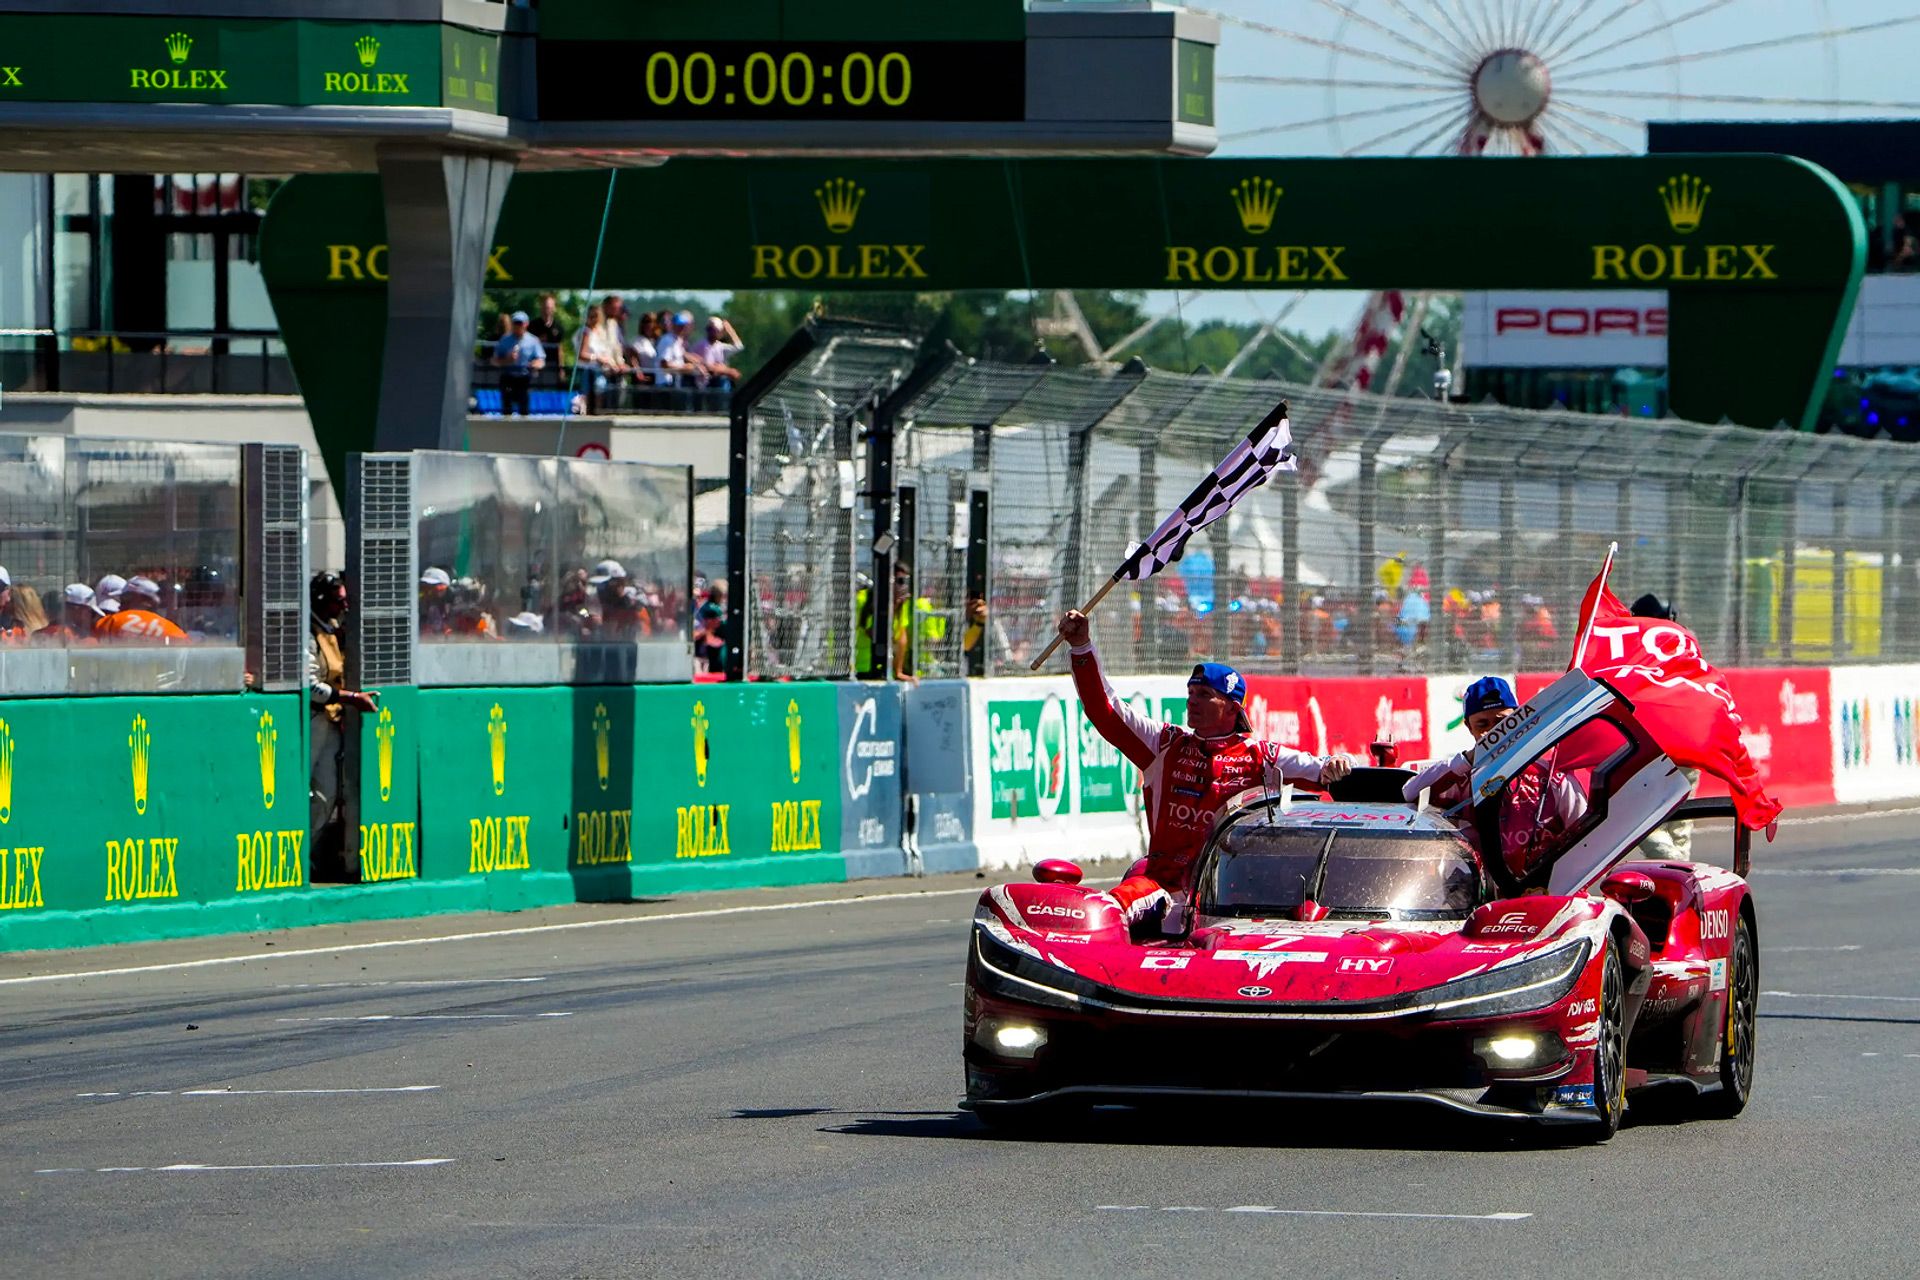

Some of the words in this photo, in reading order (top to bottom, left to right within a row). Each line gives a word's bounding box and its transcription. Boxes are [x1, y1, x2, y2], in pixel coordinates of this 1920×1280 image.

[130, 69, 227, 89] ROLEX
[325, 72, 409, 94] ROLEX
[645, 51, 912, 105] 00:00:00
[752, 244, 928, 279] ROLEX
[1166, 245, 1348, 281] ROLEX
[1592, 244, 1778, 280] ROLEX
[1478, 704, 1536, 751] TOYOTA
[1214, 754, 1253, 763] DENSO
[1171, 770, 1197, 784] Mobil
[577, 810, 633, 865] ROLEX
[676, 803, 732, 859] ROLEX
[771, 799, 822, 852] ROLEX
[236, 830, 304, 892] ROLEX
[469, 815, 531, 873] ROLEX
[0, 847, 45, 910] LEX
[105, 837, 179, 901] ROLEX
[1026, 904, 1086, 920] CASIO
[1480, 924, 1539, 935] EDIFICE
[1700, 908, 1729, 941] DENSO
[1258, 934, 1305, 950] 7
[1340, 958, 1389, 972] HY
